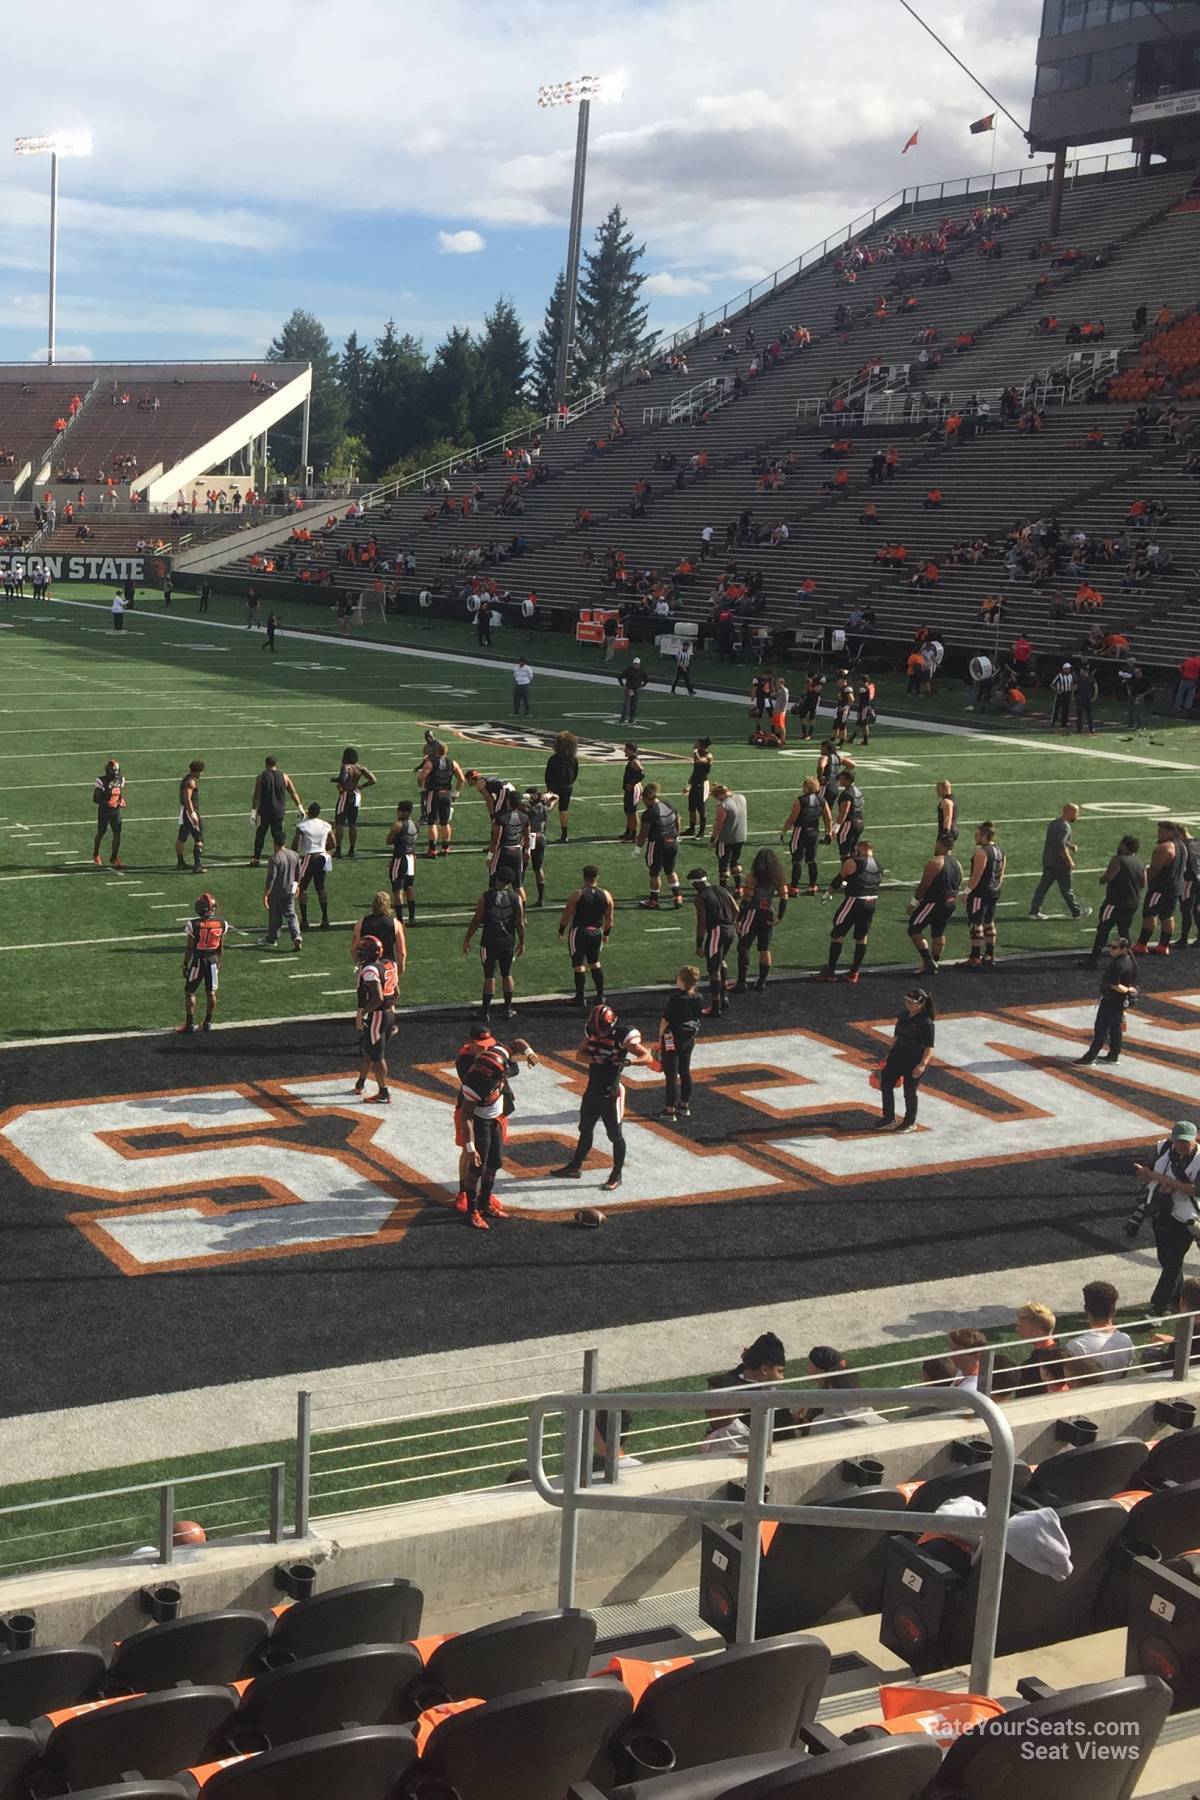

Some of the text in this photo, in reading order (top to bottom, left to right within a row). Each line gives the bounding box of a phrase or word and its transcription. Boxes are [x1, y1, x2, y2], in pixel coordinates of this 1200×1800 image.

[69, 556, 145, 580] STATE
[907, 1575, 917, 1587] 2
[1157, 1601, 1168, 1615] 3
